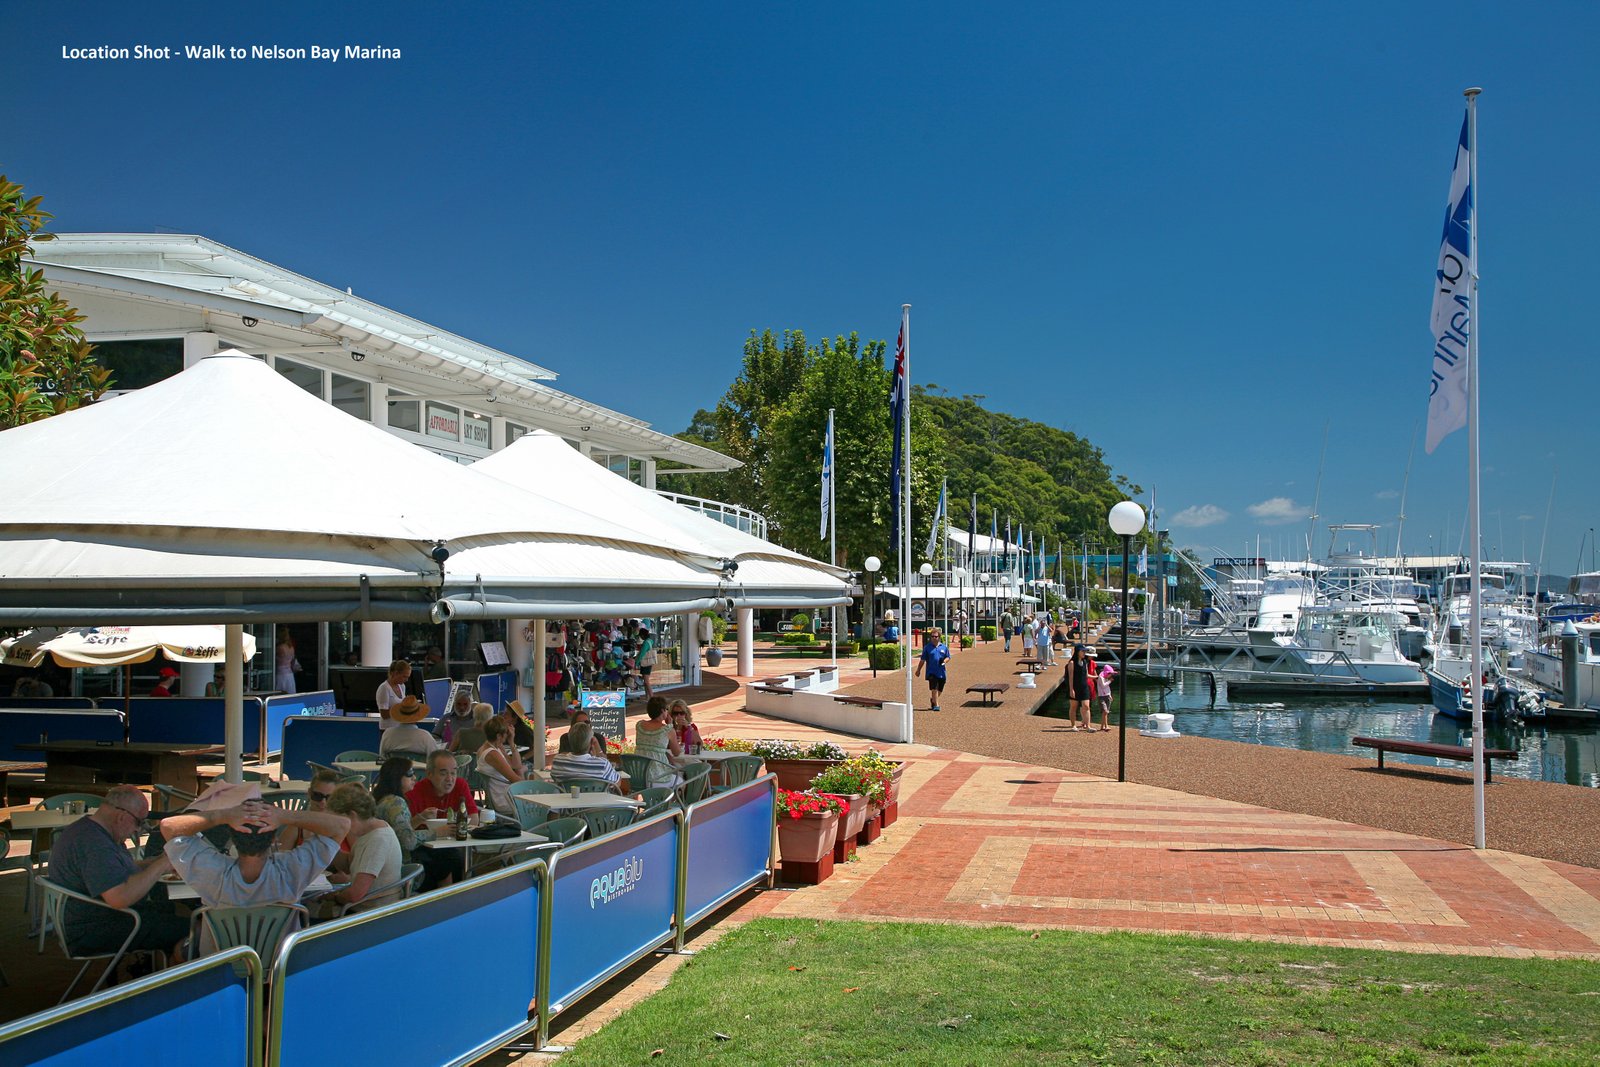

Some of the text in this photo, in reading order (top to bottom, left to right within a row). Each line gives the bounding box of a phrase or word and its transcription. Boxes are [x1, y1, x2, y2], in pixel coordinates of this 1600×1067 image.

[430, 415, 457, 434] AFFORDABLE
[464, 424, 488, 442] ART SHOW
[84, 635, 128, 645] Leffe
[194, 646, 218, 658] Leffe
[589, 709, 620, 717] Exclusive
[592, 722, 618, 732] ewellery
